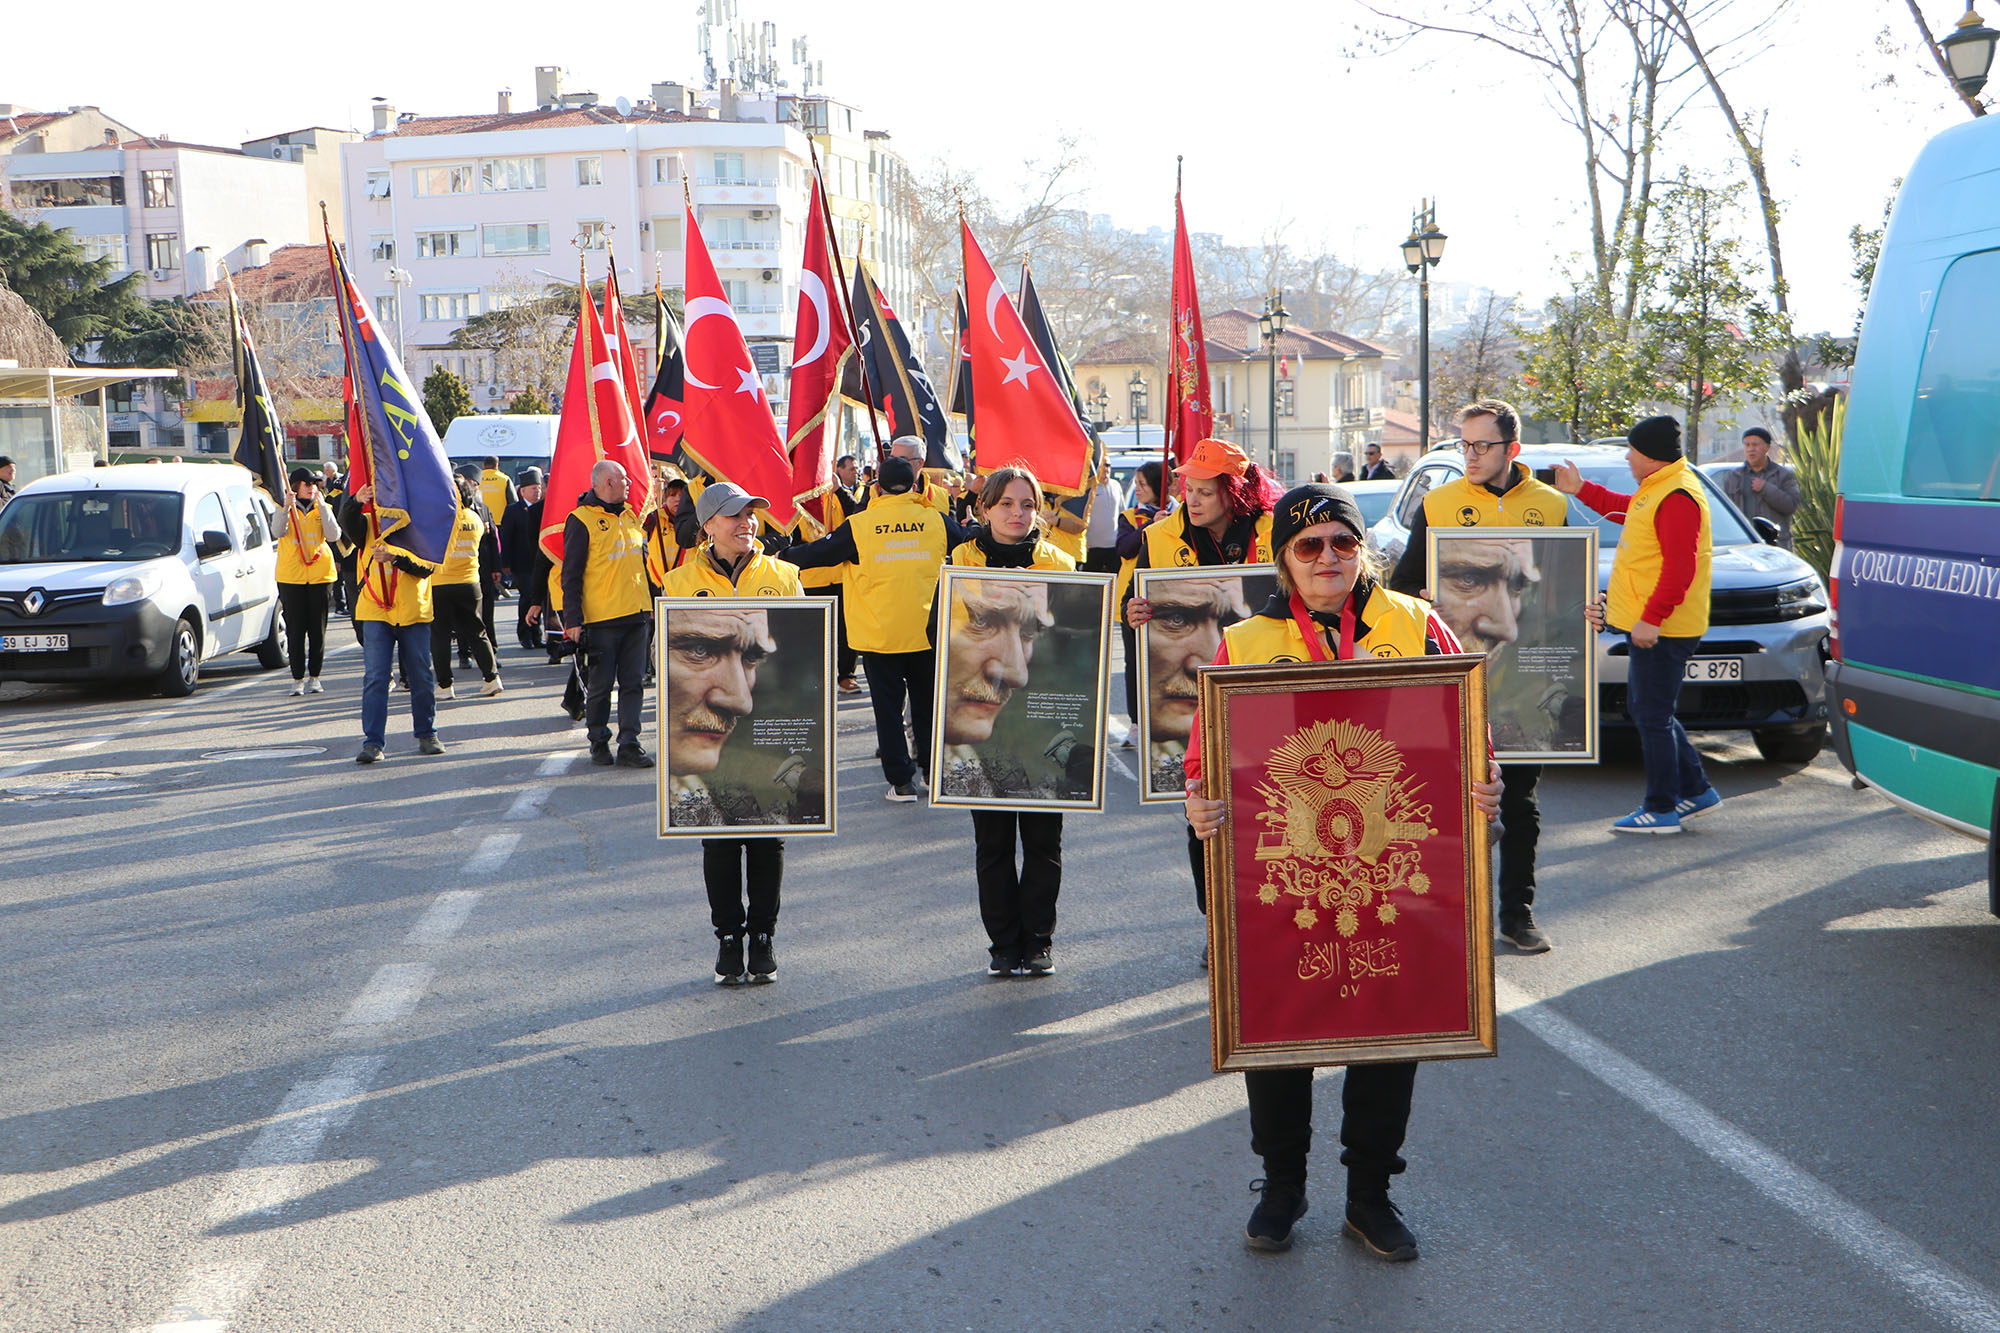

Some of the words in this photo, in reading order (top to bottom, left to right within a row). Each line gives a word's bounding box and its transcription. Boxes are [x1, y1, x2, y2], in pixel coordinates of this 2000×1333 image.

[1305, 510, 1332, 528] ALAY
[1527, 518, 1545, 526] ALAY
[1851, 550, 1913, 587] ÇORLU
[3, 637, 17, 648] 59
[24, 636, 38, 648] EJ
[46, 635, 66, 647] 376
[1708, 661, 1739, 679] 878
